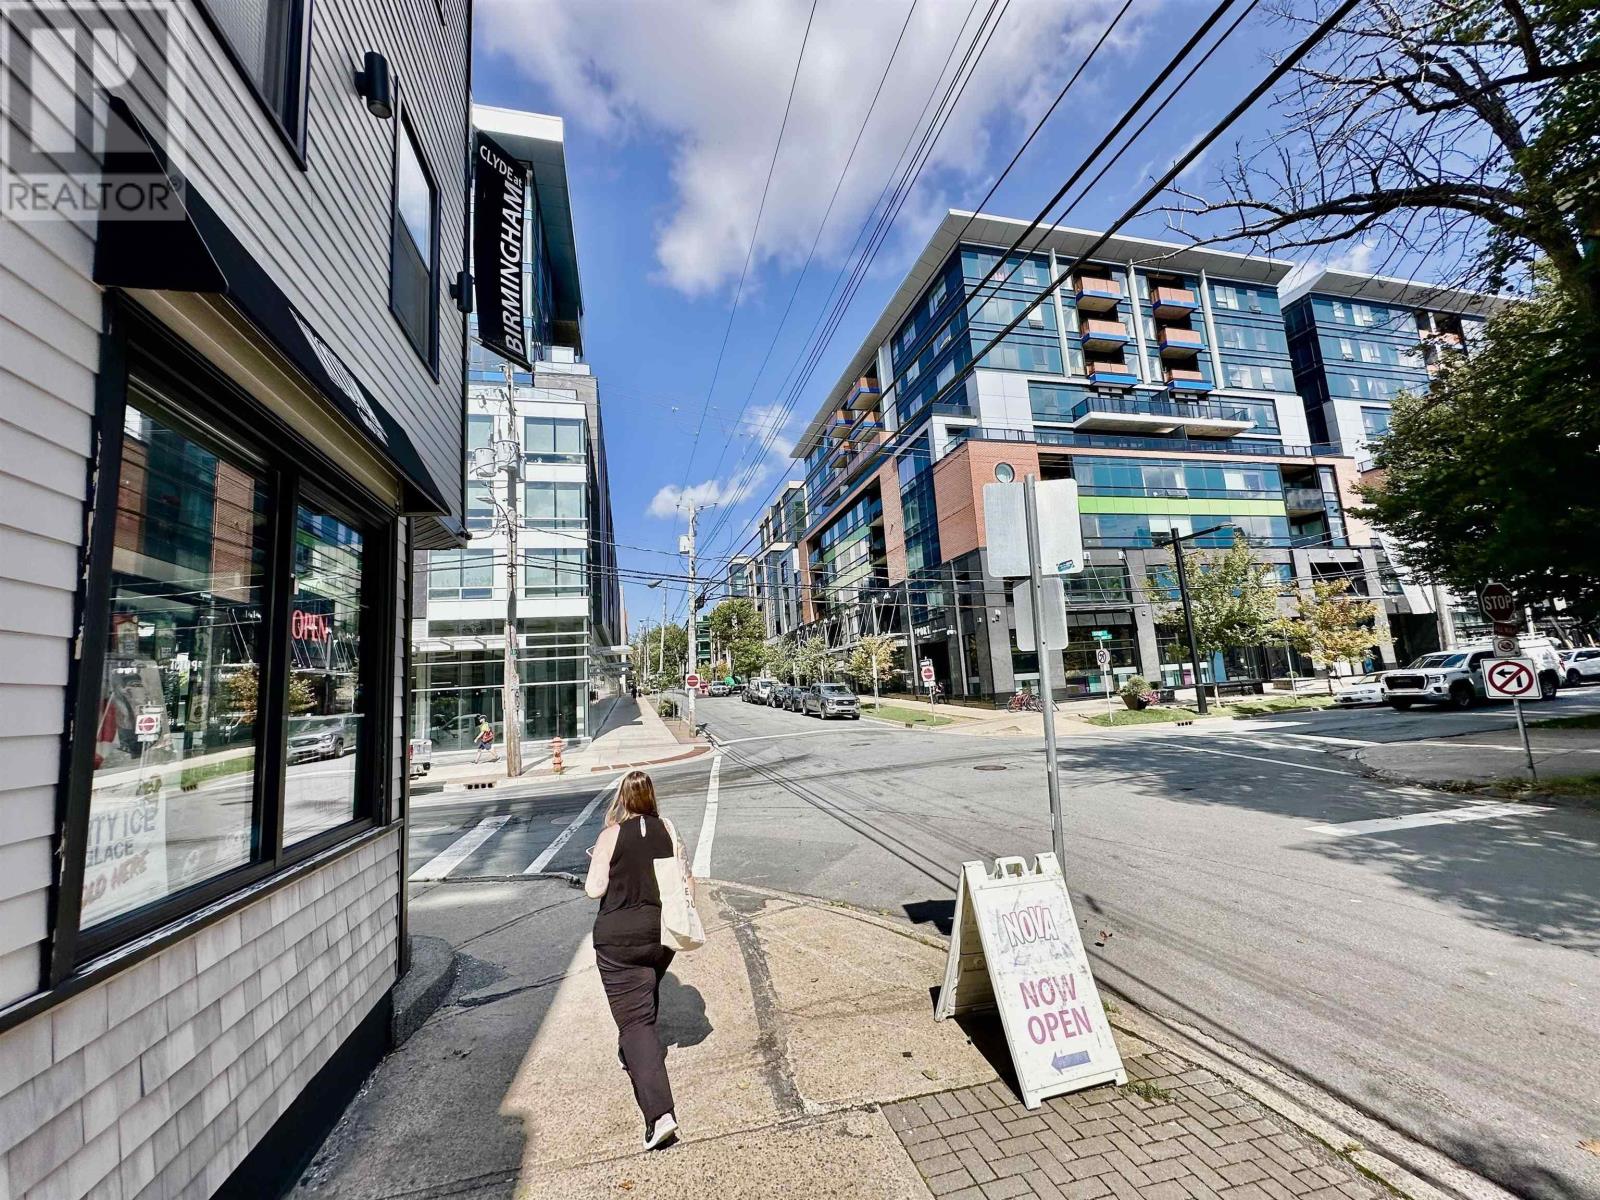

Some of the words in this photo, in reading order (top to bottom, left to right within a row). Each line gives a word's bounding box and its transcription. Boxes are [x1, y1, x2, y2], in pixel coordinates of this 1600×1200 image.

[480, 145, 514, 182] CLYDE
[500, 179, 523, 355] BIRMINGHAM
[1484, 595, 1511, 610] STOP
[291, 609, 328, 643] OPEN
[1002, 905, 1059, 947] NOVA
[1019, 973, 1077, 1009] NOW
[1027, 1006, 1093, 1045] OPEN
